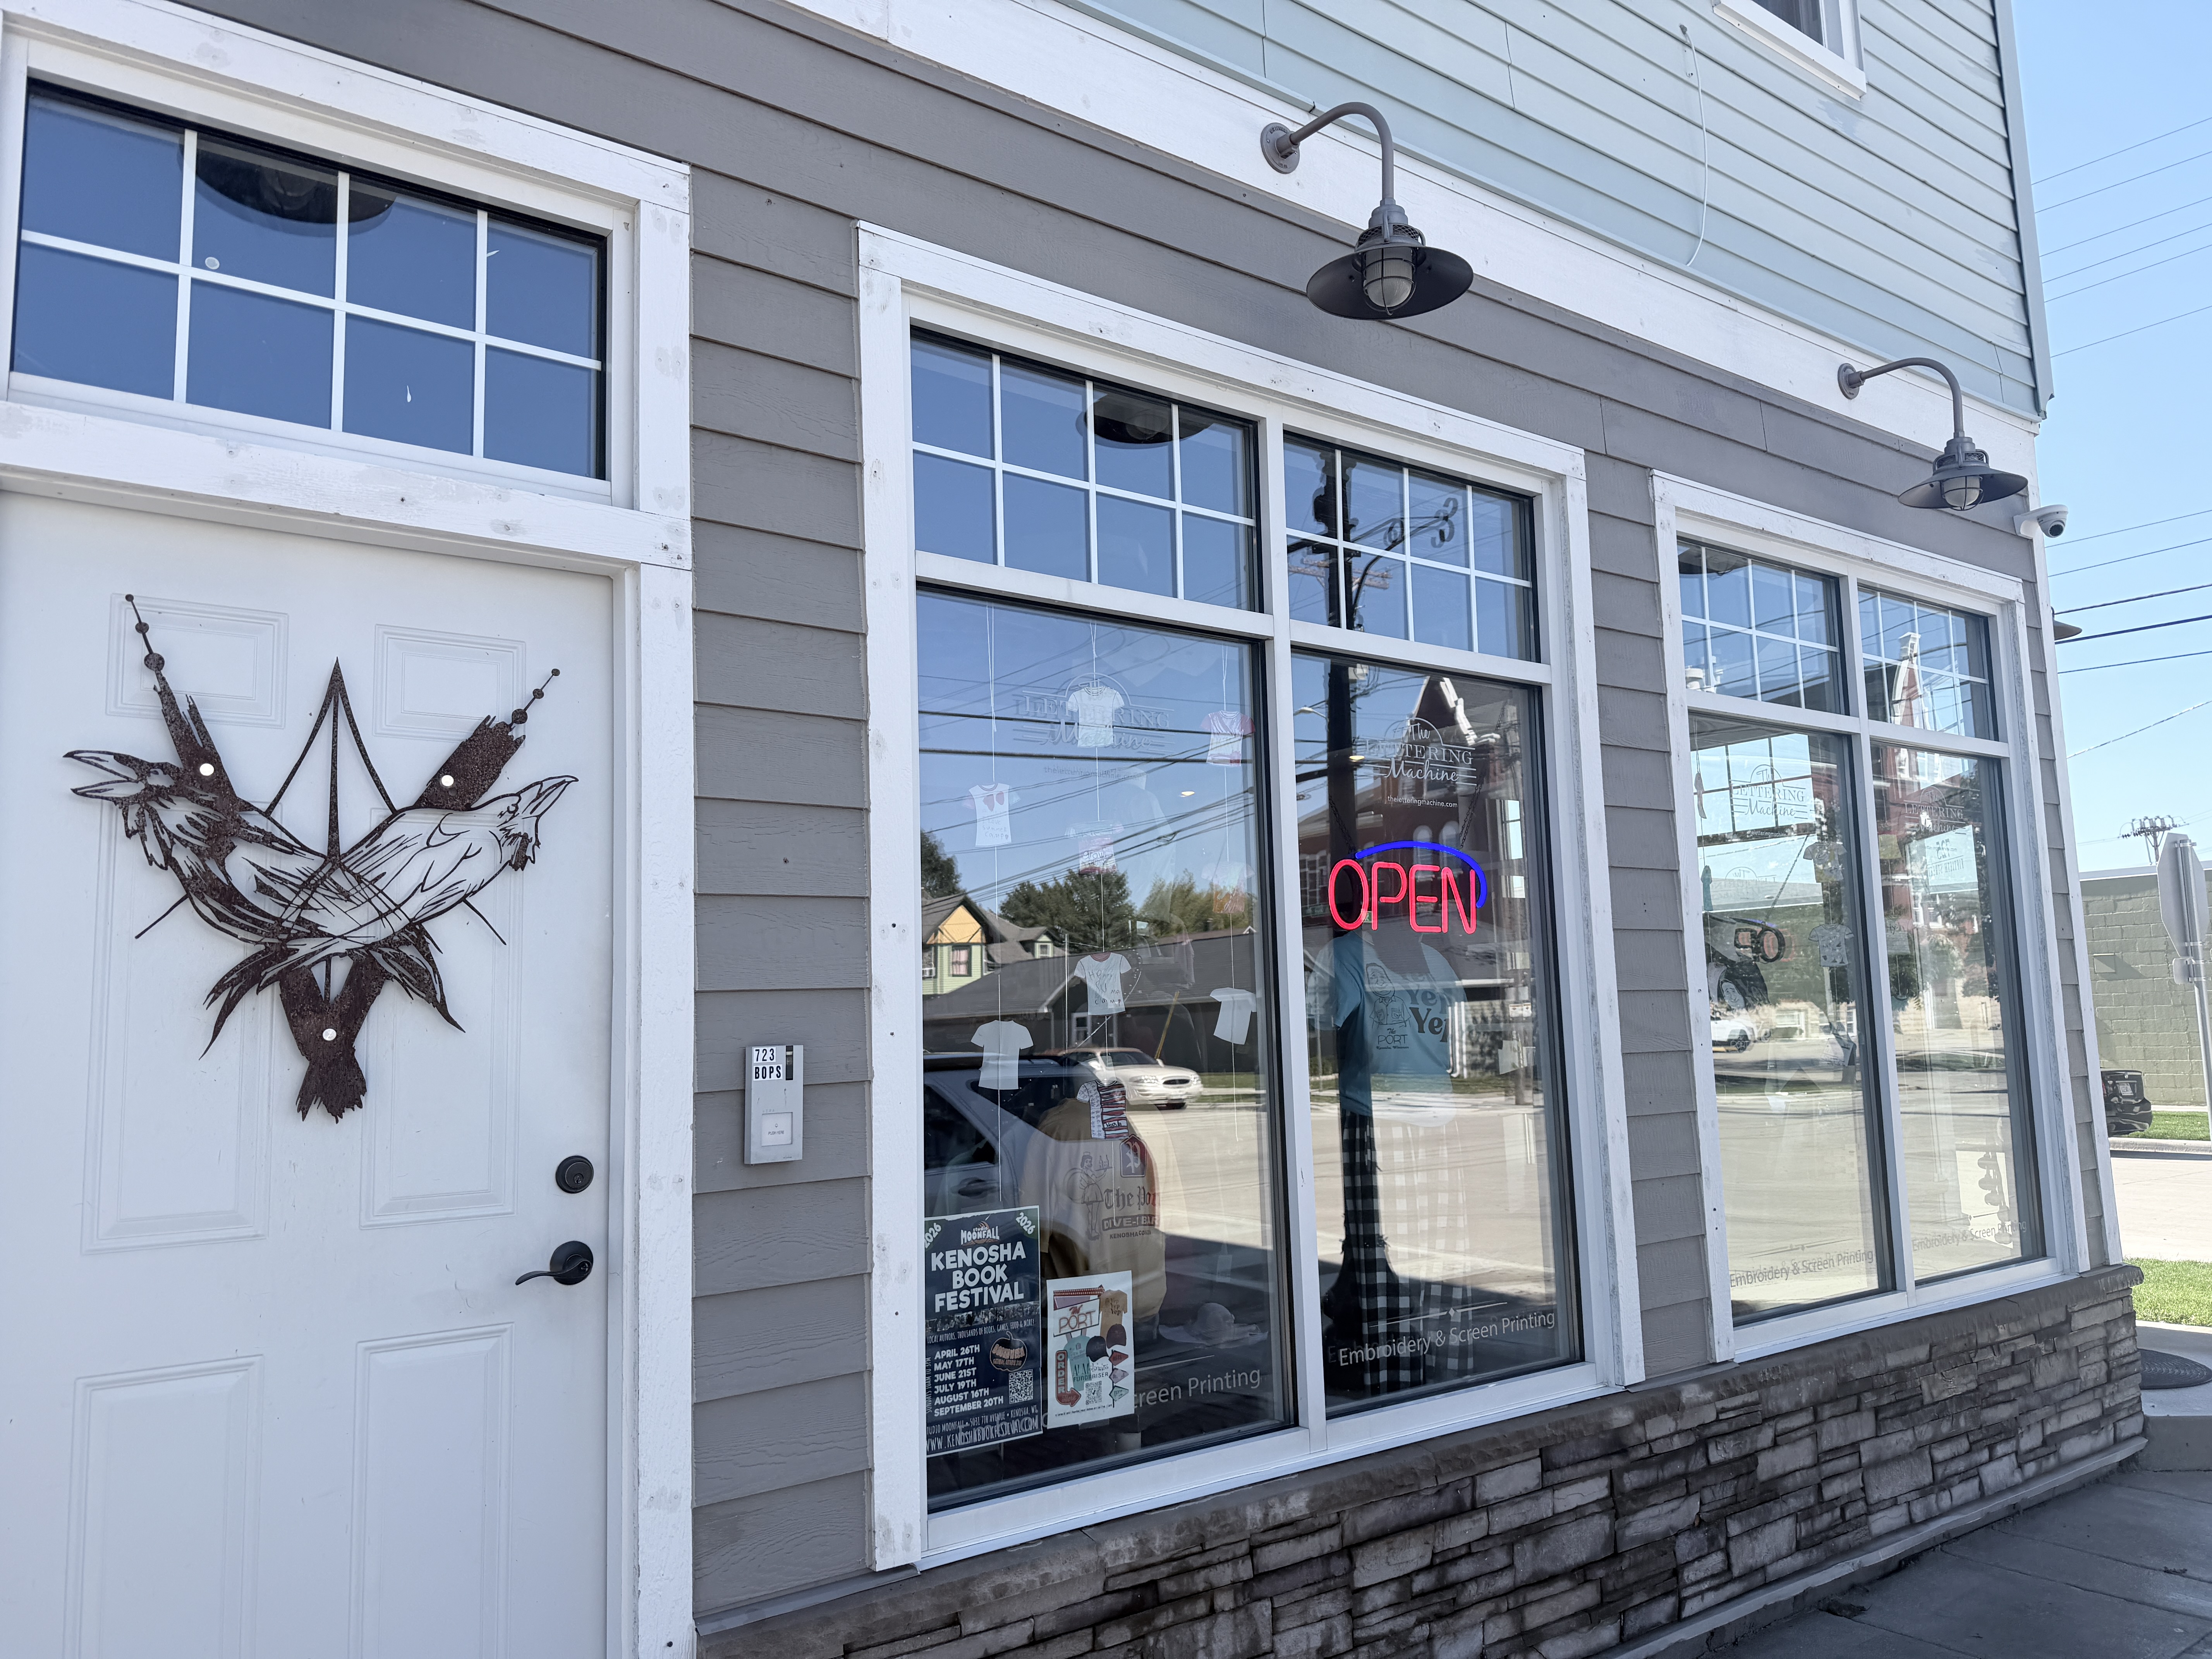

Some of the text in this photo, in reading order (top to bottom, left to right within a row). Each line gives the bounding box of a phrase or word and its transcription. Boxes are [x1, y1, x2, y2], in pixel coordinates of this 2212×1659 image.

[1384, 757, 1459, 781] Machine
[1731, 783, 1805, 802] LETTERING
[1744, 798, 1796, 816] Machine
[1328, 859, 1477, 935] OPEN
[1377, 1034, 1408, 1045] PORT
[755, 1048, 775, 1062] 723
[754, 1065, 781, 1080] BOPS
[1104, 1186, 1159, 1211] The Por
[1016, 1212, 1036, 1235] 2026
[1970, 1227, 1996, 1241] Screen
[925, 1222, 941, 1249] 2026
[960, 1226, 1000, 1245] MOONFALL
[931, 1241, 1026, 1271] KENOSHA
[952, 1263, 1008, 1289] BOOK
[1730, 1249, 1874, 1288] Embroidery & Screen Printing
[935, 1281, 1024, 1313] FESTIVAL
[927, 1334, 939, 1344] LOCAL
[957, 1328, 978, 1339] THOUSANDS
[1010, 1321, 1019, 1329] FOOD
[1059, 1310, 1096, 1334] PORT
[1340, 1312, 1555, 1366] Embroidery & Screen Printing
[934, 1348, 958, 1360] APRIL
[960, 1344, 980, 1355] 26TH
[934, 1356, 974, 1371] MAY 17TH
[934, 1367, 977, 1382] JUNE 21ST
[1057, 1353, 1065, 1394] ORDER
[934, 1378, 977, 1394] JULY 19TH
[934, 1387, 989, 1406] AUGUST 16TH
[1134, 1385, 1182, 1409] reen
[1188, 1369, 1261, 1397] Printing
[934, 1395, 1004, 1417] SEPTEMBER 20TH
[926, 1424, 941, 1435] TUDIO
[942, 1419, 965, 1432] MOONFALL
[970, 1416, 981, 1427] 5031
[989, 1411, 1005, 1423] AVENUE
